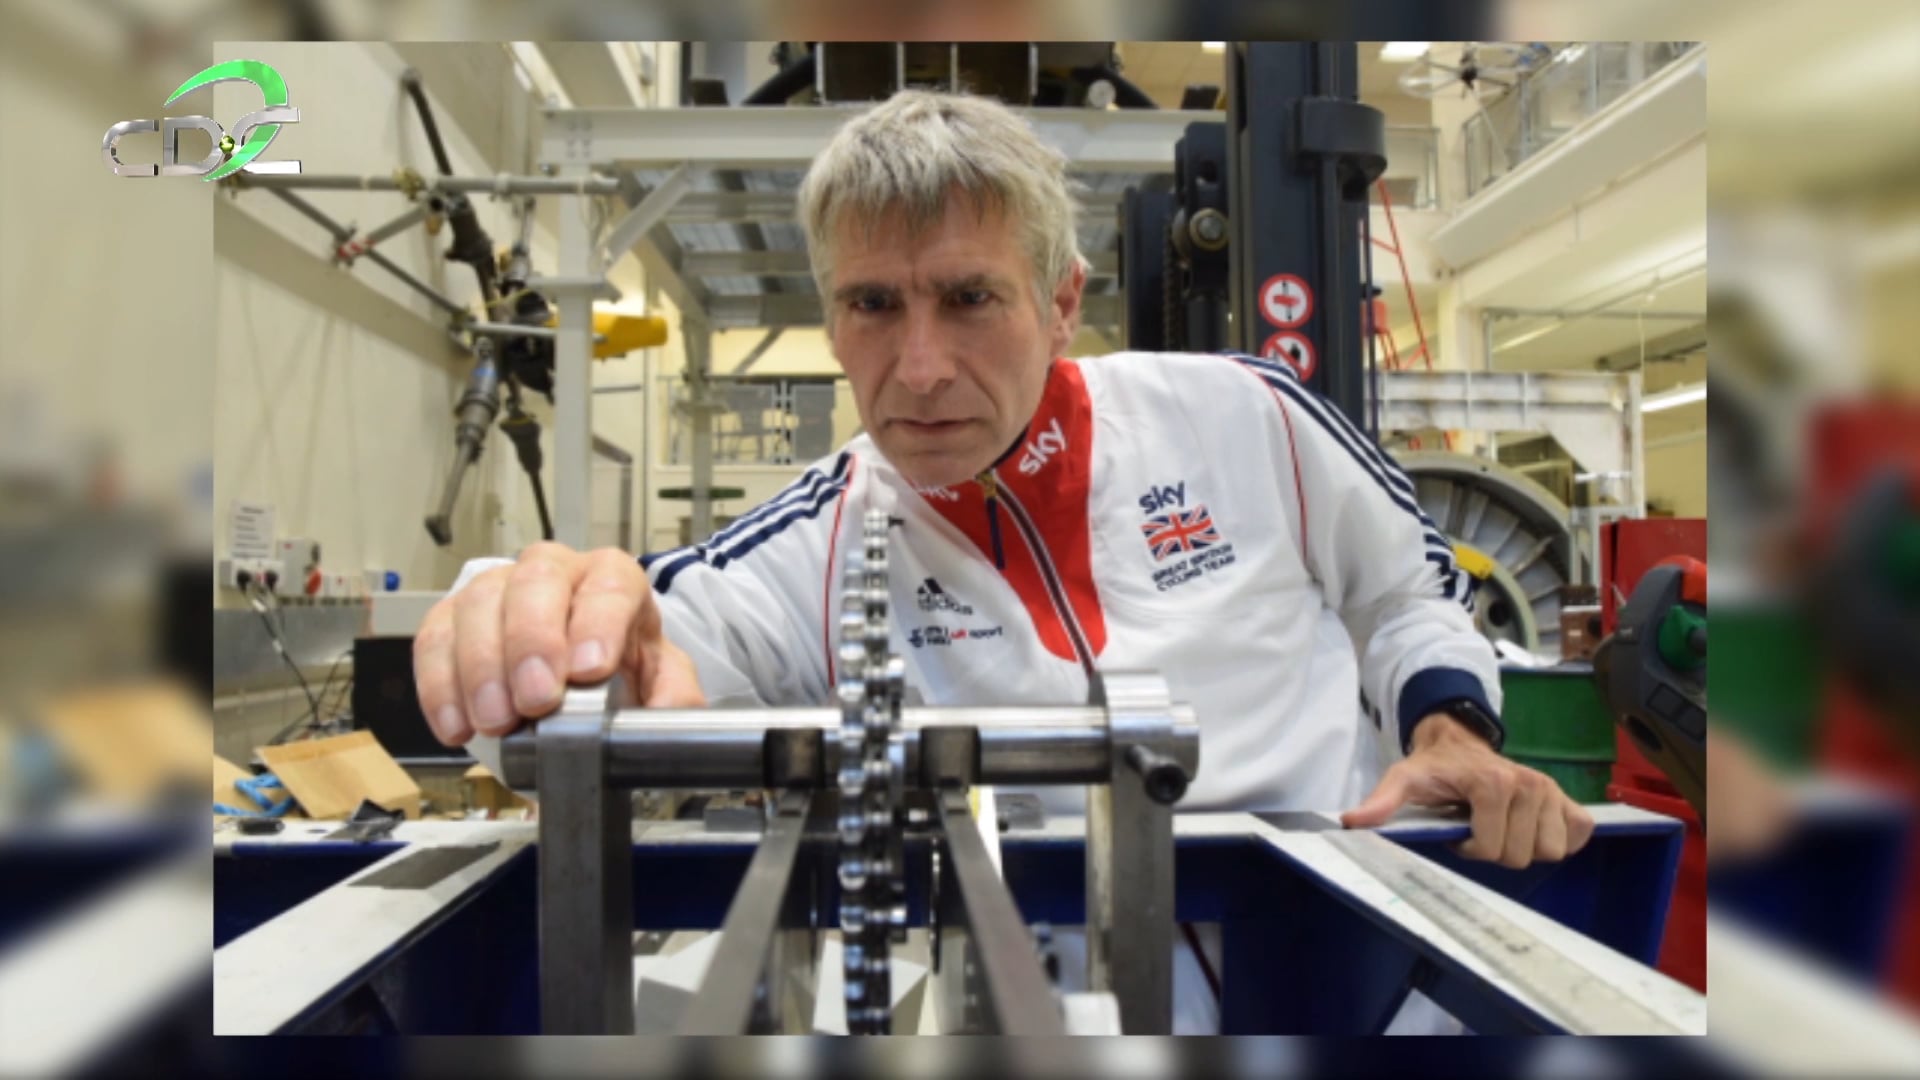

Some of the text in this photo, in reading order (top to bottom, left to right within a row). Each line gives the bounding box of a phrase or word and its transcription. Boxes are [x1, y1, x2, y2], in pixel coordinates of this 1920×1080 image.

[1018, 416, 1067, 474] sky
[1138, 480, 1185, 515] sky
[1156, 554, 1236, 592] CYCLING TEAM
[917, 593, 974, 616] adidas
